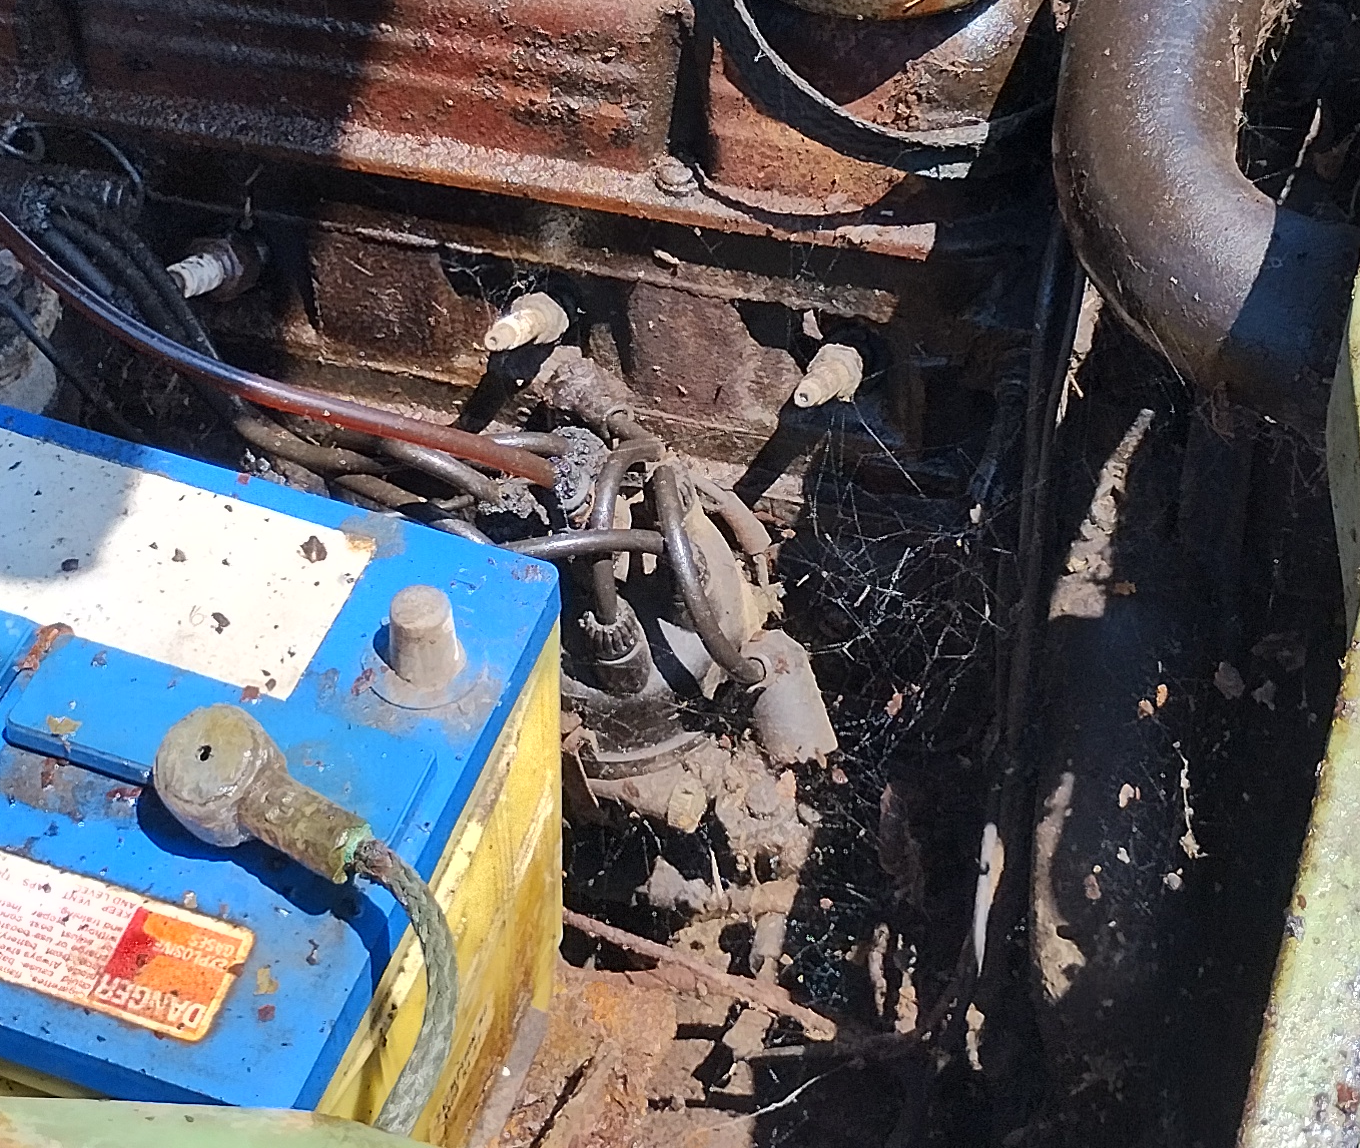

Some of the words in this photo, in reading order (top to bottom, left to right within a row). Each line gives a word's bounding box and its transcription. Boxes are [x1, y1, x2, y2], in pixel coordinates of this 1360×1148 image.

[20, 877, 52, 893] APS
[74, 884, 110, 901] LEVEL
[61, 890, 92, 906] VENT
[111, 895, 137, 909] AND
[30, 907, 68, 926] roper
[101, 902, 132, 919] KEEP
[102, 921, 123, 933] and
[54, 939, 68, 949] or
[185, 932, 236, 958] GASES
[21, 949, 62, 970] Always
[91, 971, 208, 1029] DANGER
